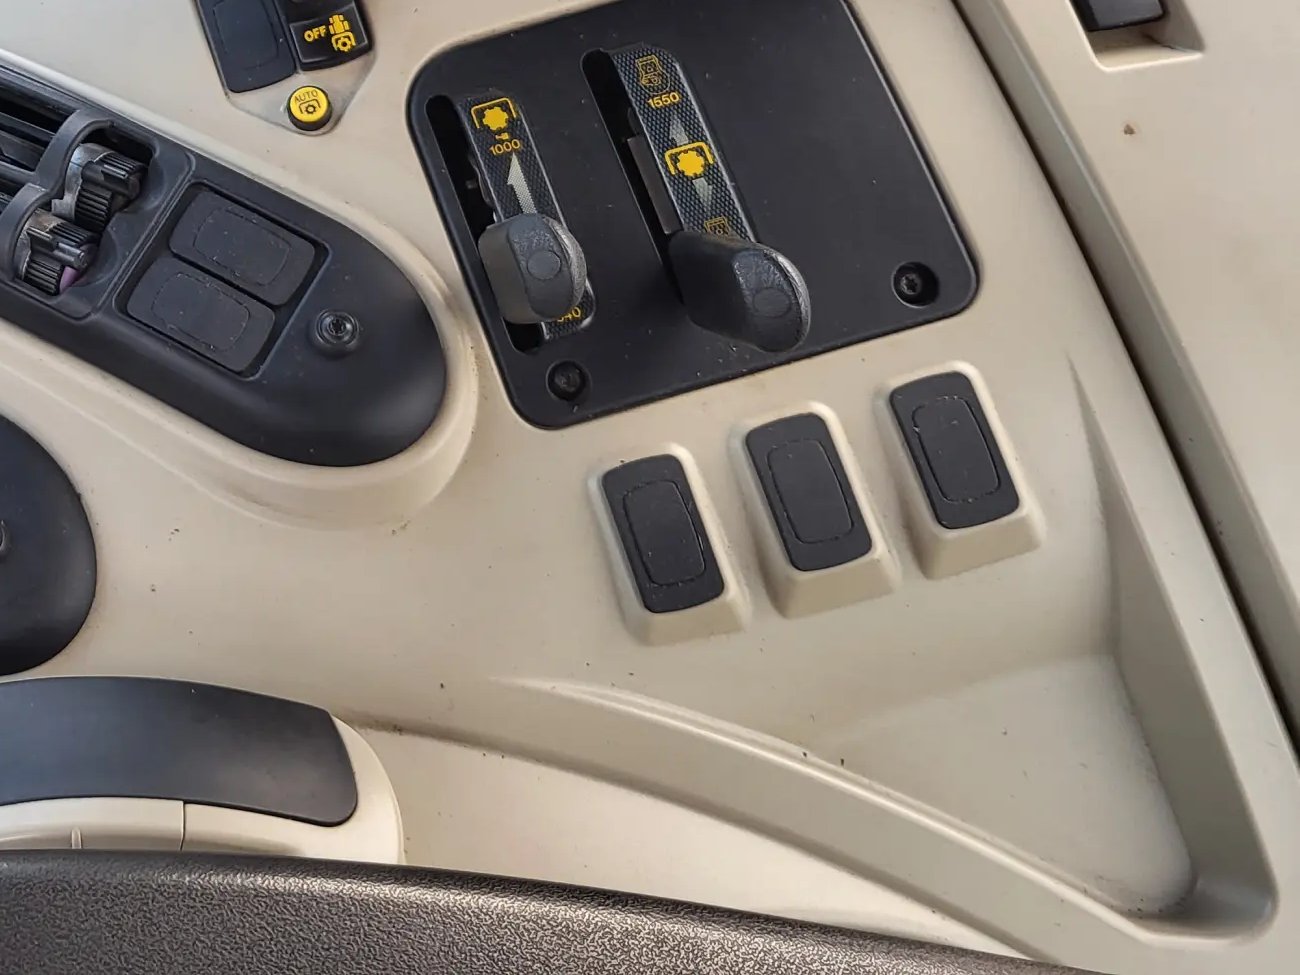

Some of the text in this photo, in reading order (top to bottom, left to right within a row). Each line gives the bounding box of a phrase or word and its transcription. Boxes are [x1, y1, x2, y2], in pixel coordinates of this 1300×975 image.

[303, 25, 326, 42] OFF
[294, 89, 319, 104] AUTO
[647, 92, 680, 108] 1550
[489, 138, 521, 155] 1000
